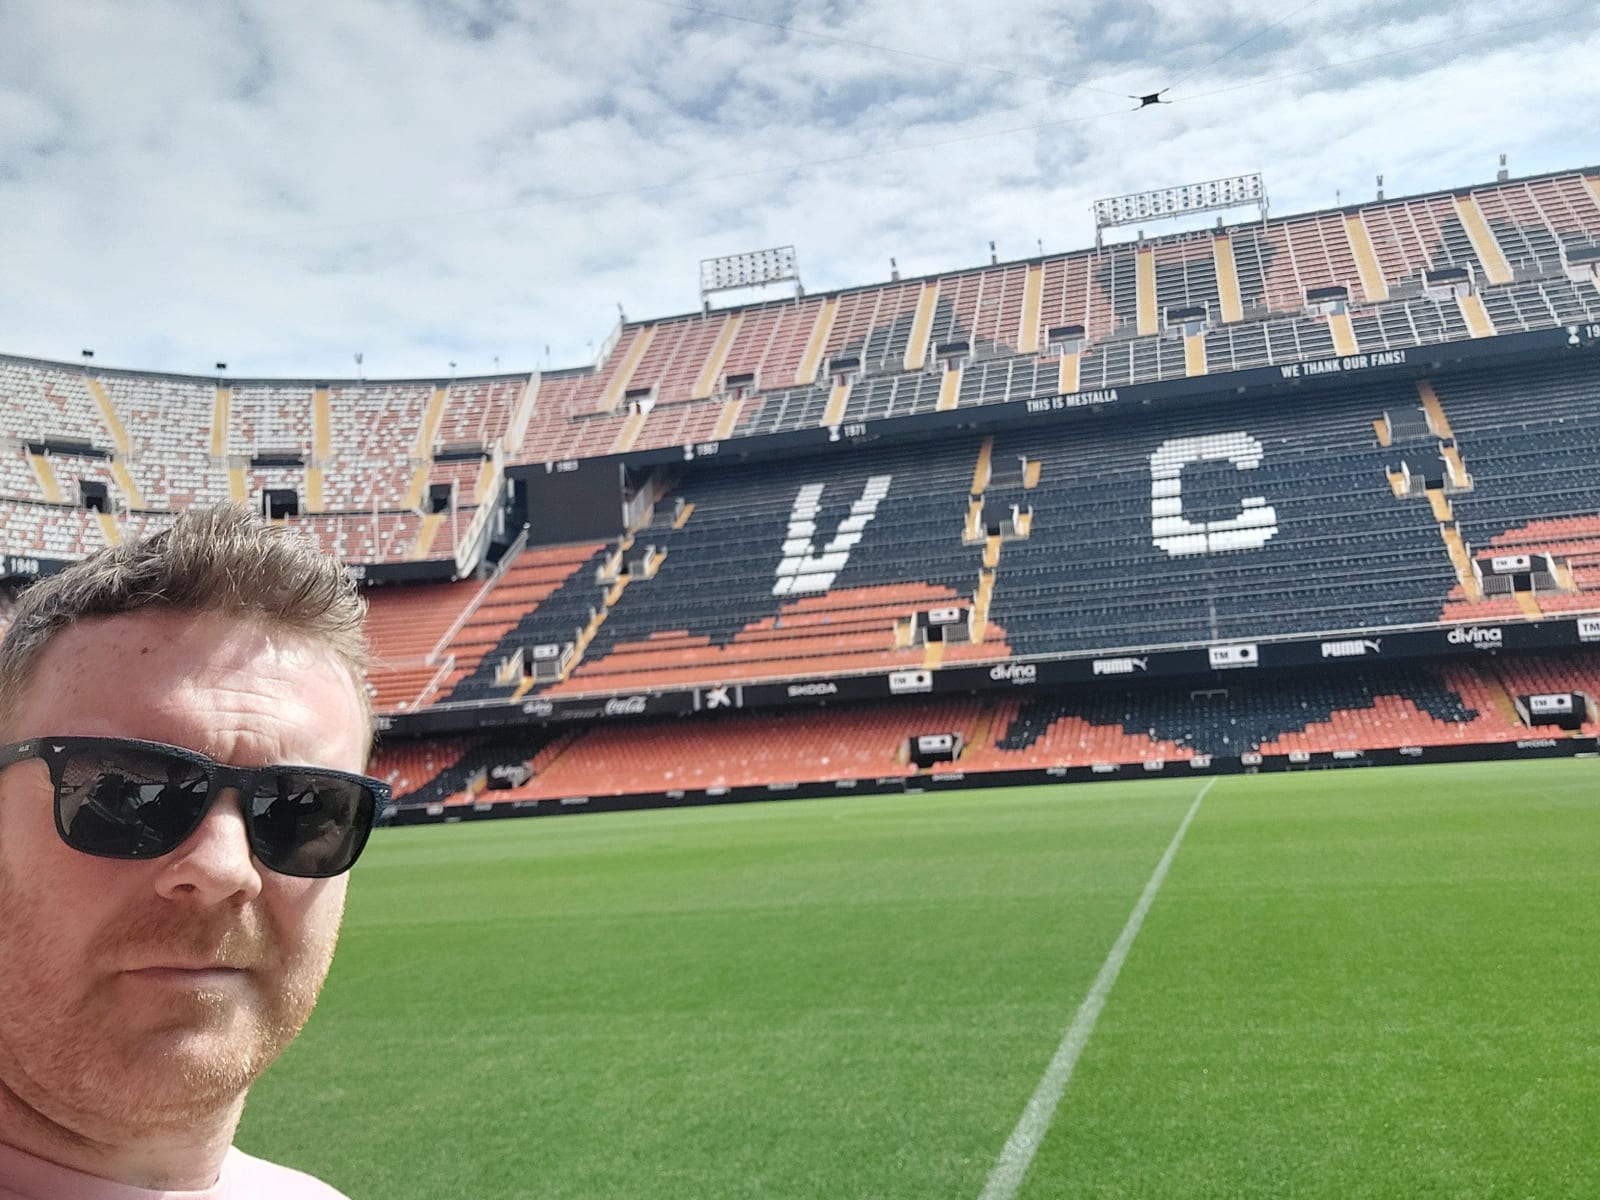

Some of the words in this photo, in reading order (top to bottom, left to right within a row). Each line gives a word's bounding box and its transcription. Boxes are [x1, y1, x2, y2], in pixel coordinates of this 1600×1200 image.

[1280, 364, 1300, 379] WE
[1302, 358, 1341, 376] THANK
[1342, 355, 1368, 371] OUR
[1370, 350, 1406, 367] FANS!
[1026, 398, 1050, 413] THIS
[1052, 396, 1064, 409] IS
[1065, 388, 1118, 407] MESTALLA
[1150, 431, 1279, 557] C
[10, 557, 39, 575] 1949
[1447, 627, 1502, 644] divina
[1321, 639, 1366, 658] PUMA
[990, 662, 1036, 681] divina
[1093, 657, 1134, 676] PUMA
